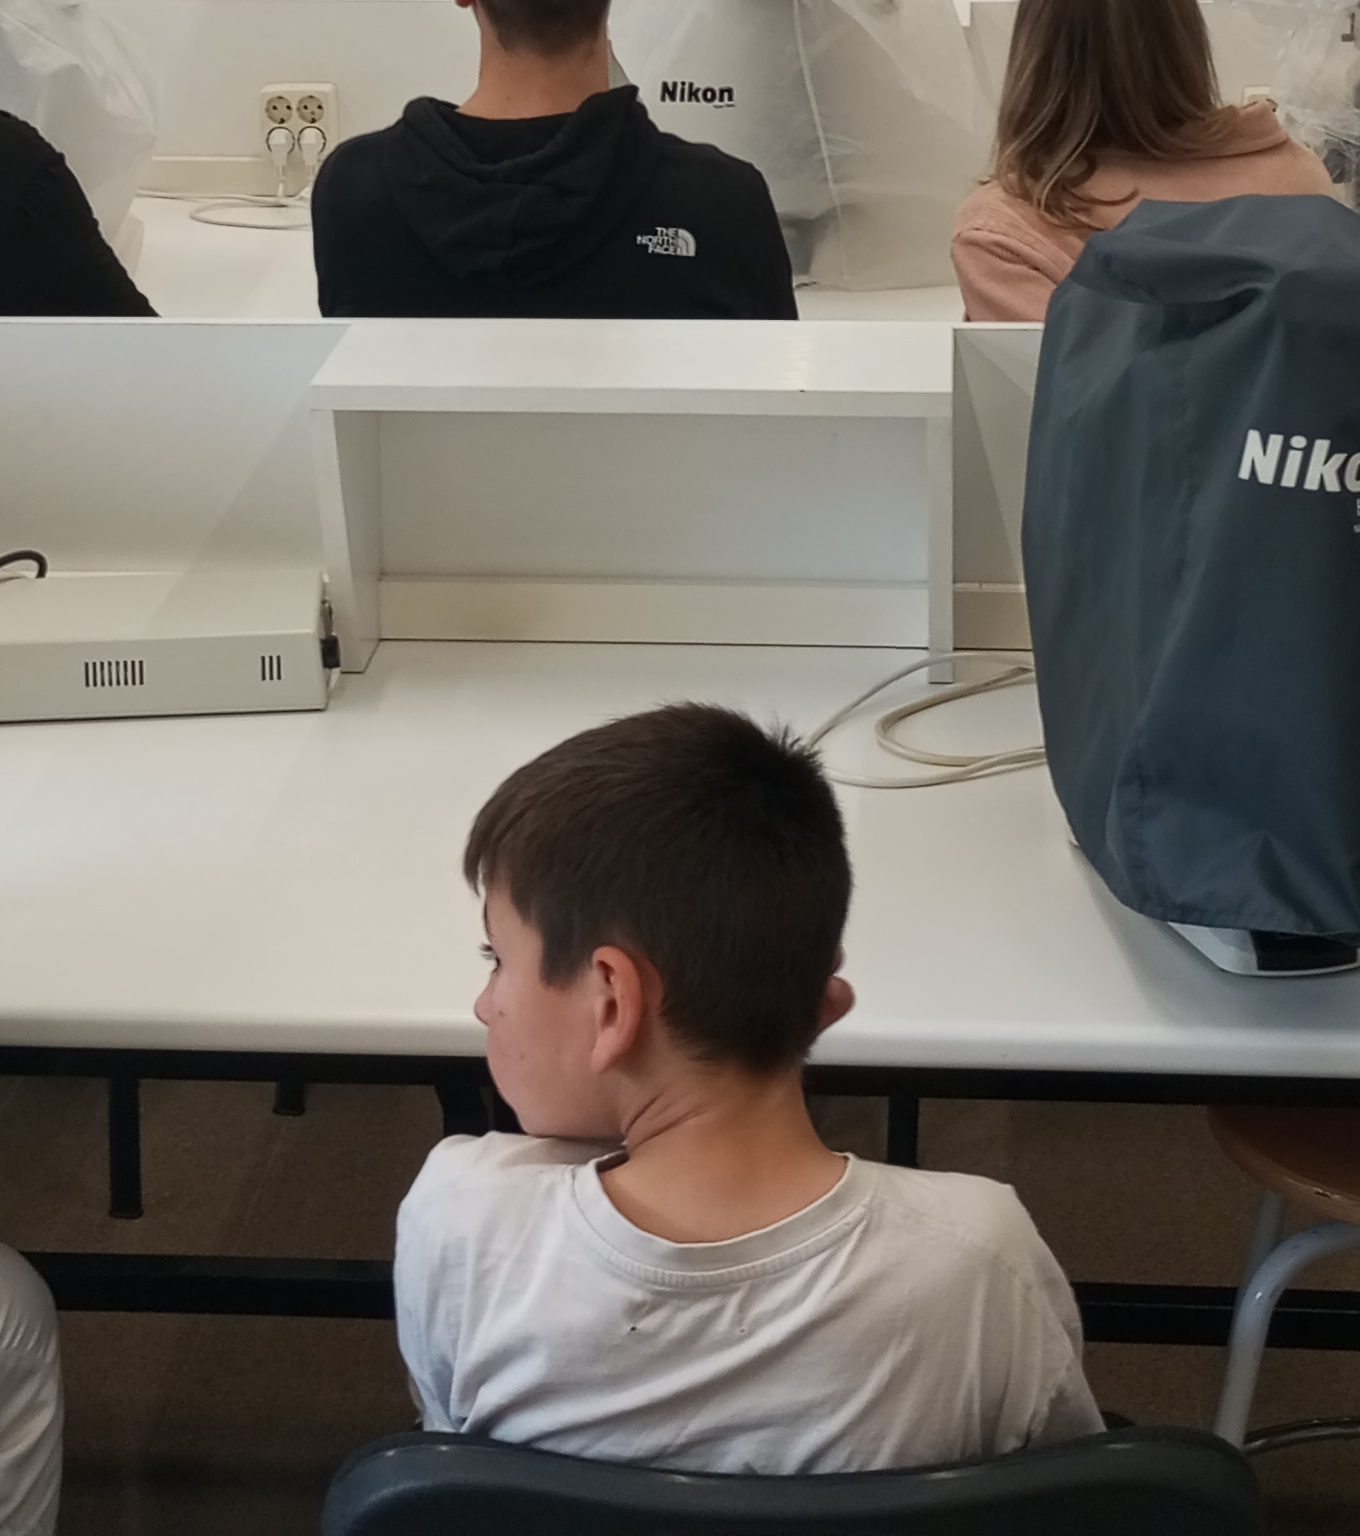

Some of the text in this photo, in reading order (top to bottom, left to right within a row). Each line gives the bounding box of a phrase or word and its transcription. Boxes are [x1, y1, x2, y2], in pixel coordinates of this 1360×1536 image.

[660, 81, 735, 103] Nikon
[654, 226, 677, 237] THE
[636, 235, 676, 247] NORTH
[648, 244, 676, 255] FACE
